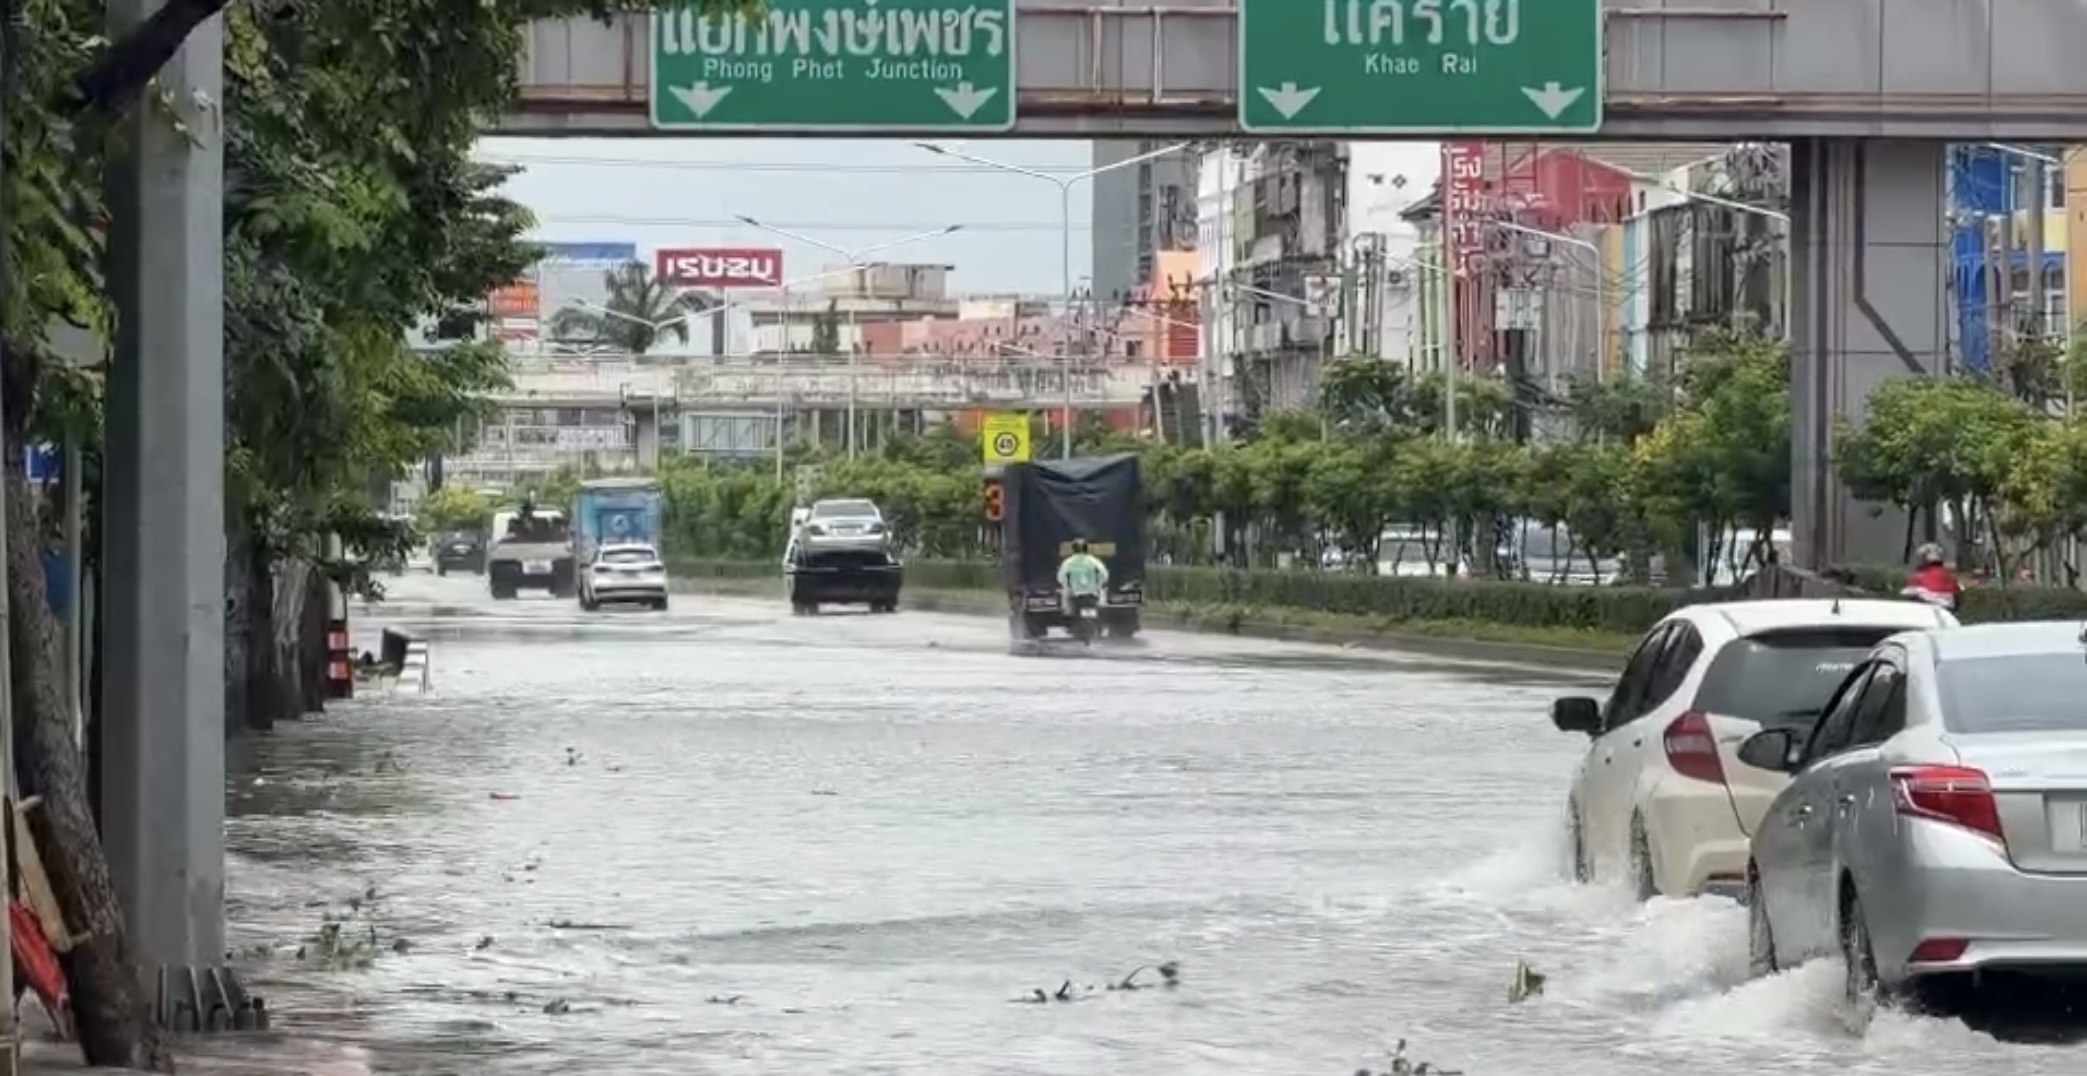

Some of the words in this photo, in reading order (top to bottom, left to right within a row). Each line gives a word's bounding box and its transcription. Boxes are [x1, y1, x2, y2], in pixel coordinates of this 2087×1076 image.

[703, 58, 773, 83] Phong
[792, 58, 844, 79] Phet
[865, 58, 963, 80] Junction
[1364, 53, 1420, 75] Khae
[1442, 53, 1478, 75] Rai
[665, 256, 774, 279] ISUZU
